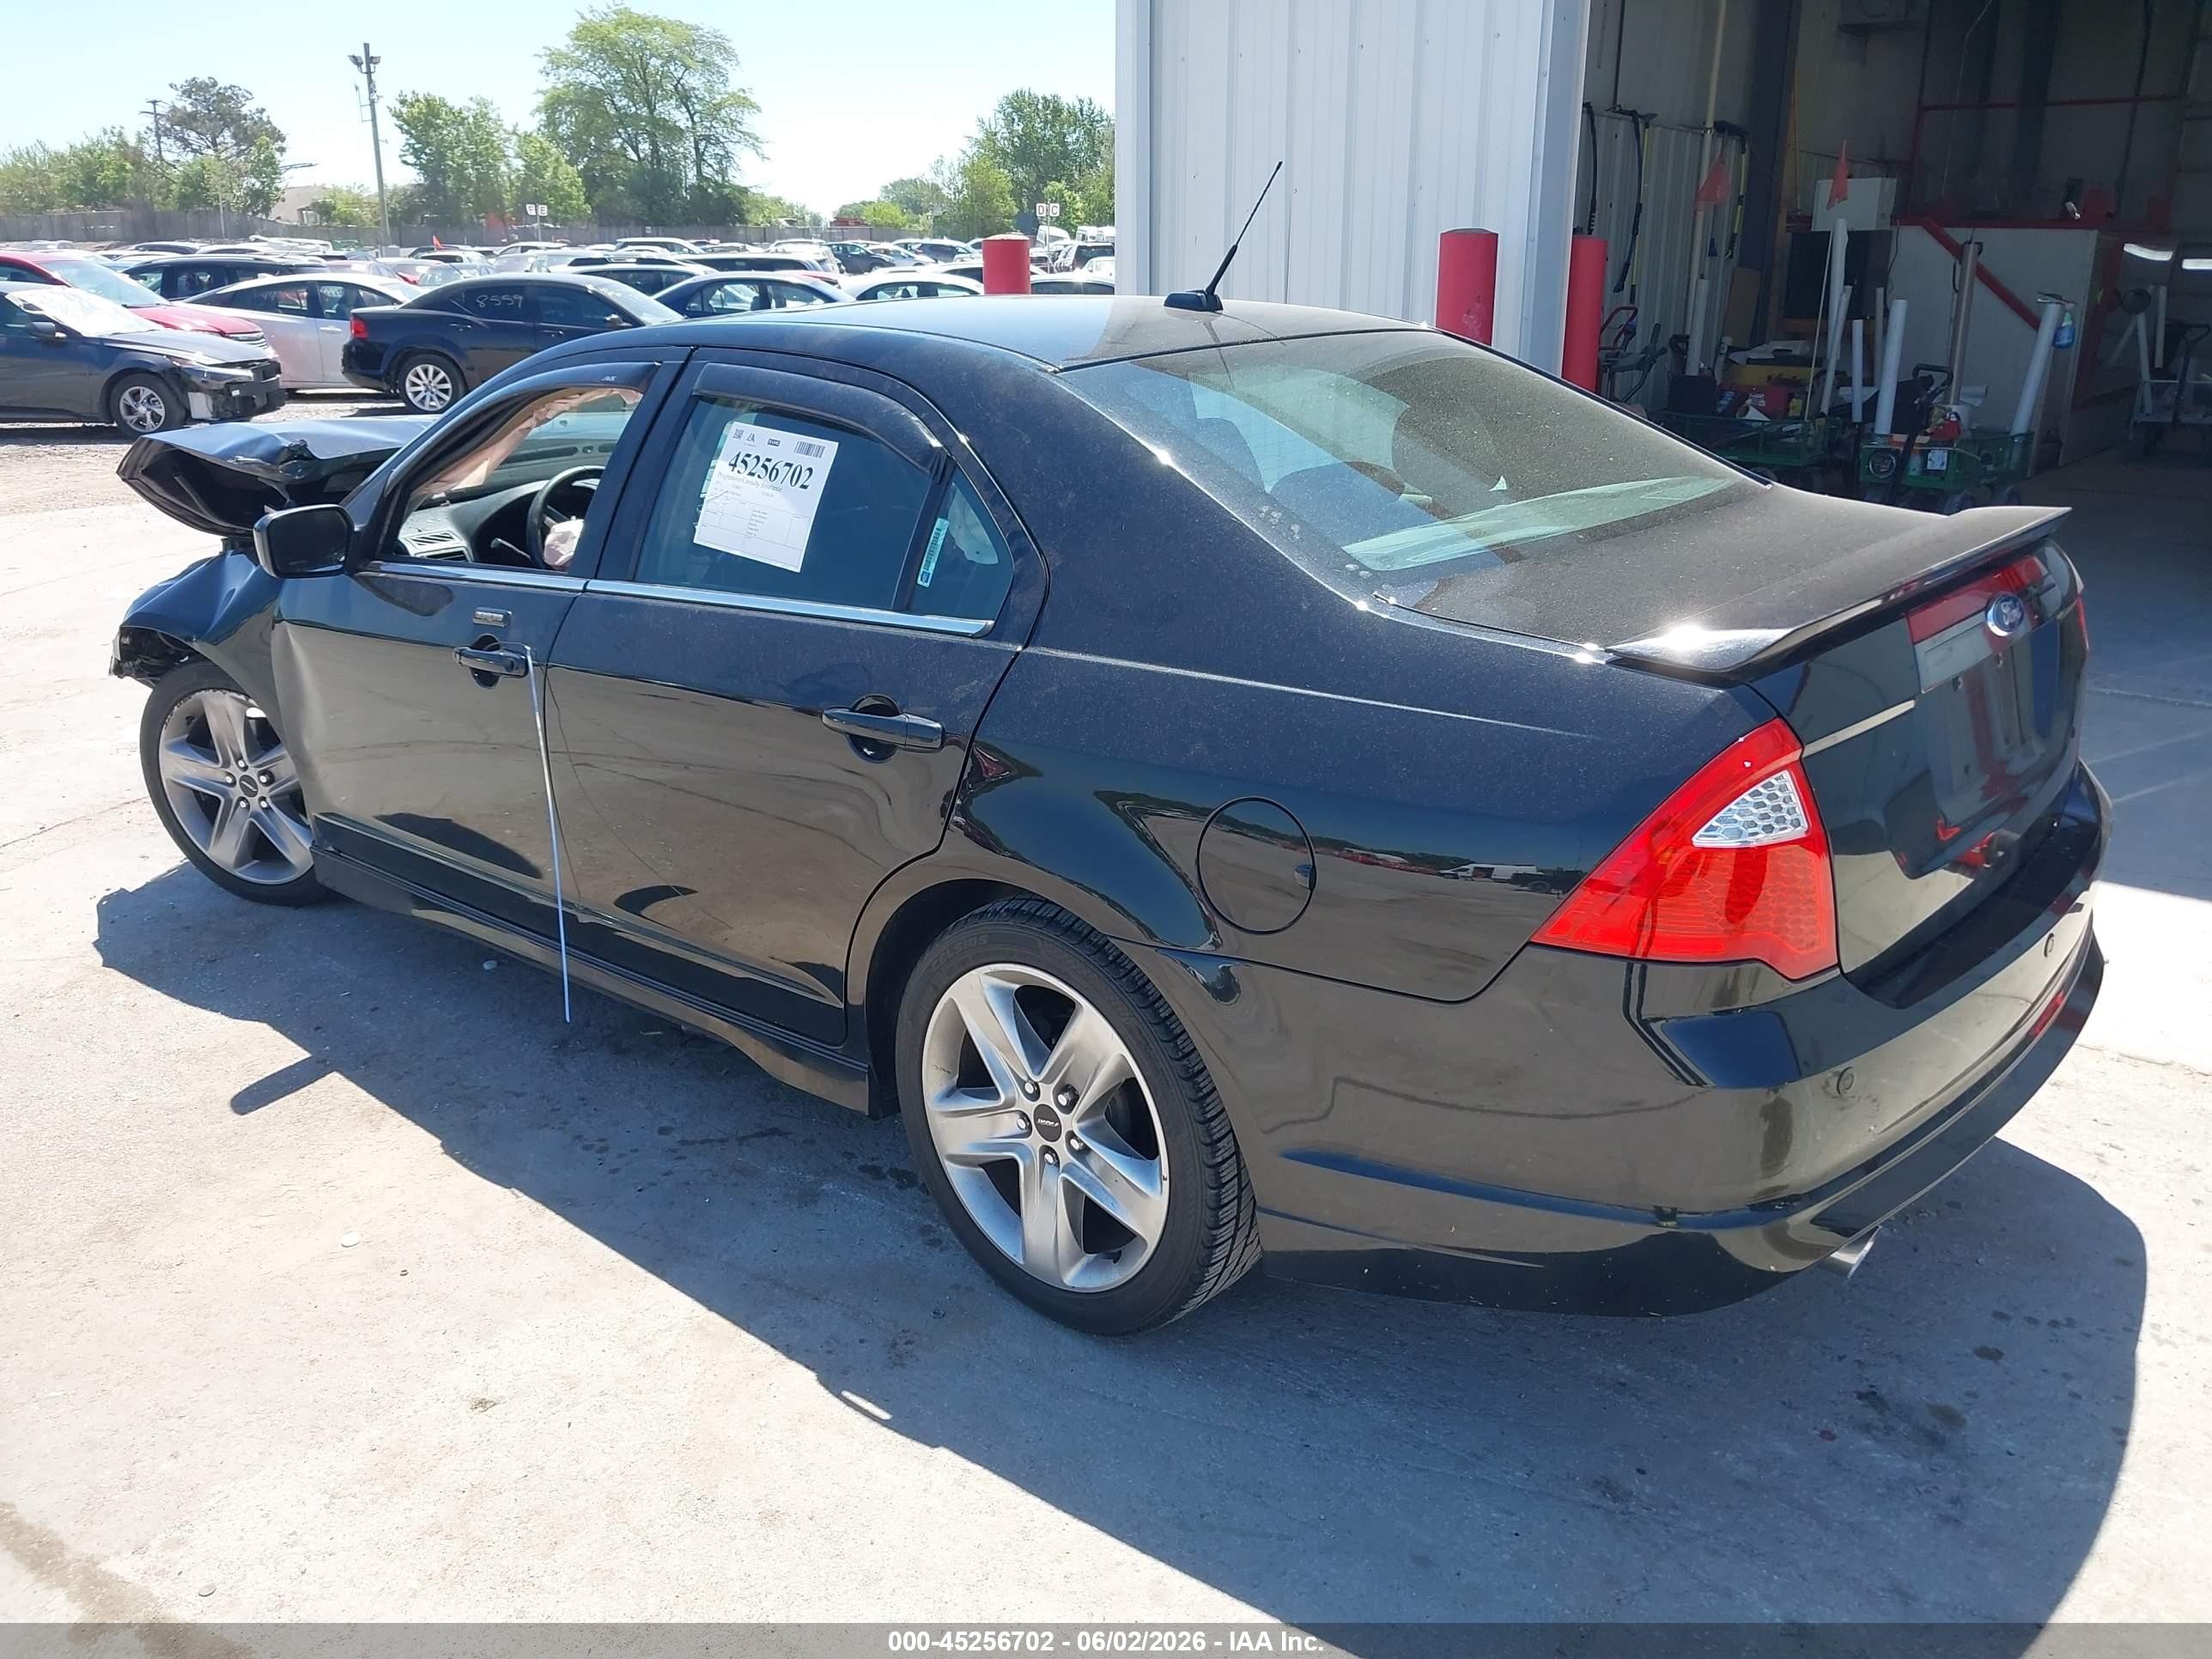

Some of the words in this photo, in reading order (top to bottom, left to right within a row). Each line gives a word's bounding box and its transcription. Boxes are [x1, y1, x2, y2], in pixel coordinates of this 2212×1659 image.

[1039, 205, 1044, 214] D
[1052, 205, 1058, 215] C
[476, 294, 523, 308] 8559
[728, 451, 813, 489] 45256702
